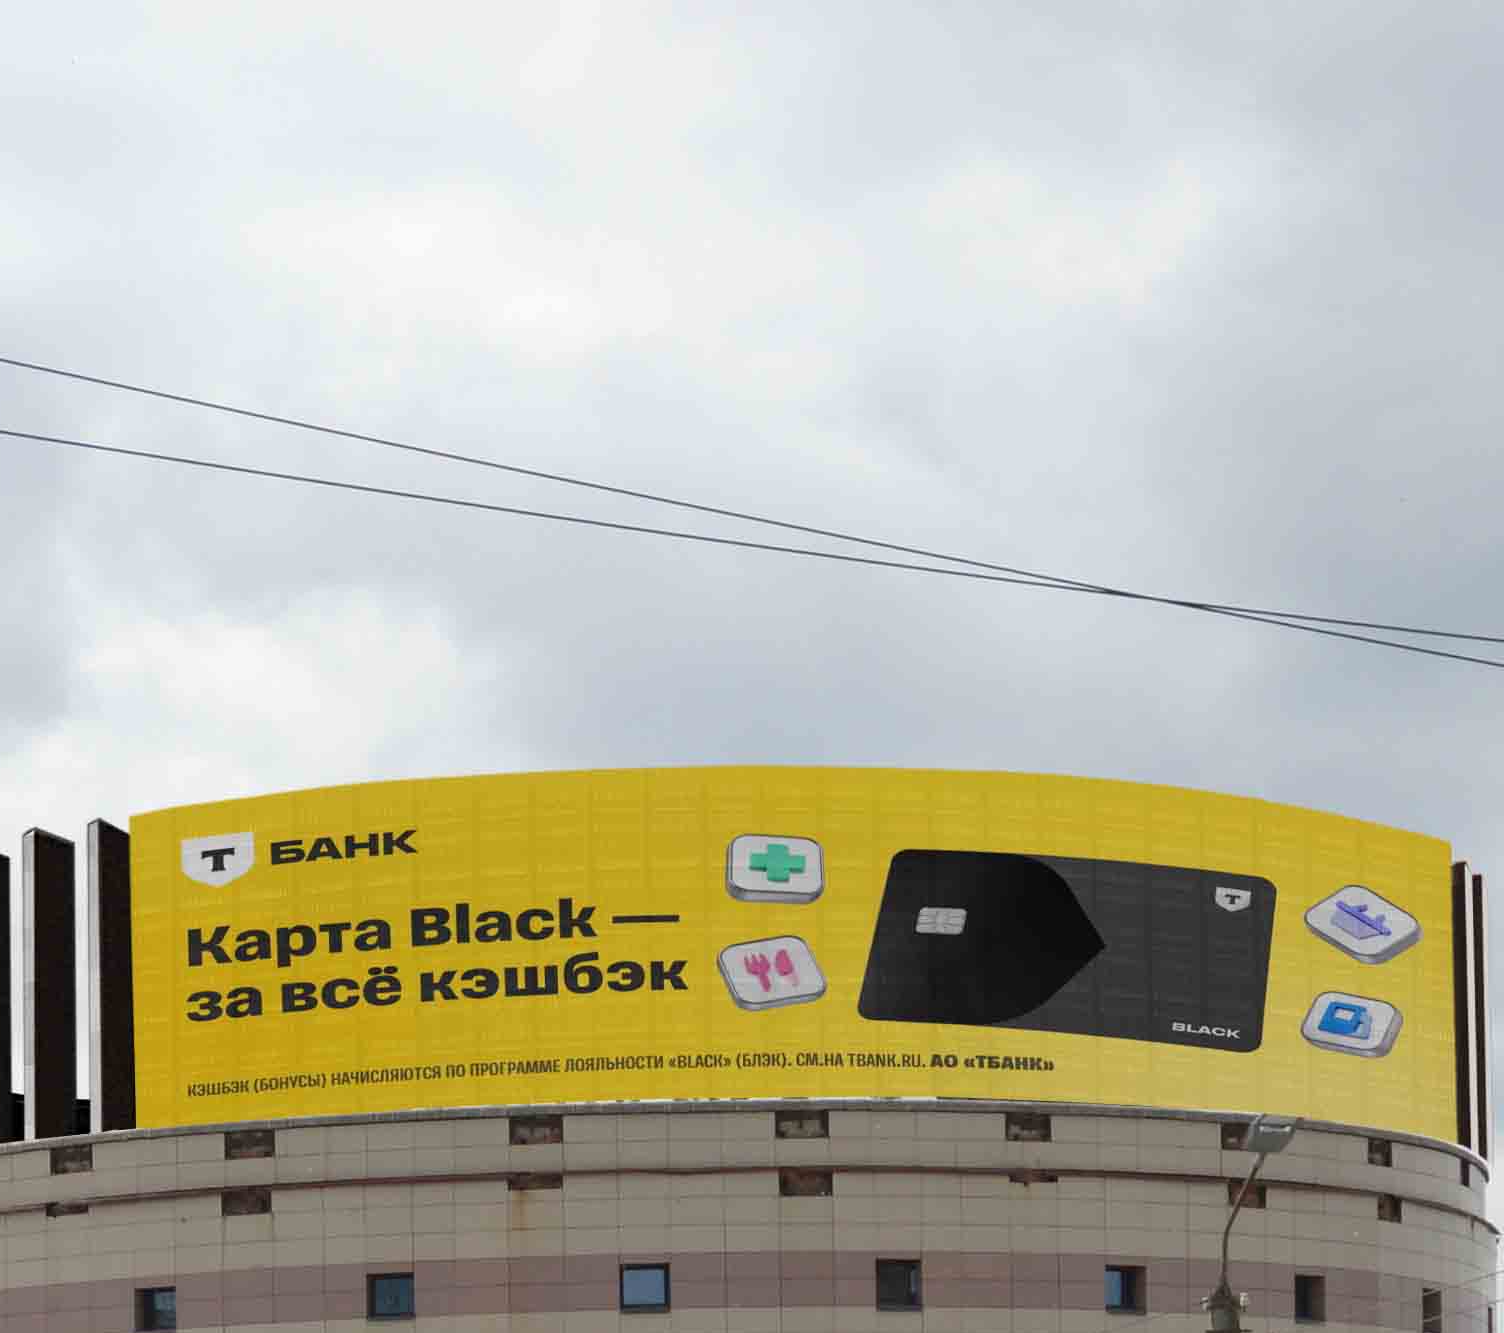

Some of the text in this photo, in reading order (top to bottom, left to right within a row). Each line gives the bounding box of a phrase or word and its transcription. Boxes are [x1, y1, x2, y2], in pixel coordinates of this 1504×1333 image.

[271, 830, 418, 866] БАНК
[187, 917, 391, 968] Карта
[411, 898, 596, 949] Black
[186, 952, 687, 1023] за всё кэшбэк
[1172, 1022, 1241, 1040] BLACK
[188, 1080, 249, 1099] КЭШБЭК
[253, 1072, 327, 1095] (БОНУСЫ)
[331, 1065, 442, 1087] НАЧИСЛЯЮТСЯ
[445, 1063, 466, 1079] ПО
[470, 1059, 561, 1078] ПРОГРАММЕ
[564, 1054, 664, 1074] ЛОЯЛЬНОСТИ
[668, 1053, 731, 1070] «BLACK»
[736, 1052, 793, 1070] (БЛЭК).
[848, 1053, 926, 1070] TBANK.RU.
[930, 1054, 958, 1070] АО
[963, 1055, 1055, 1073] «ТБАНК»
